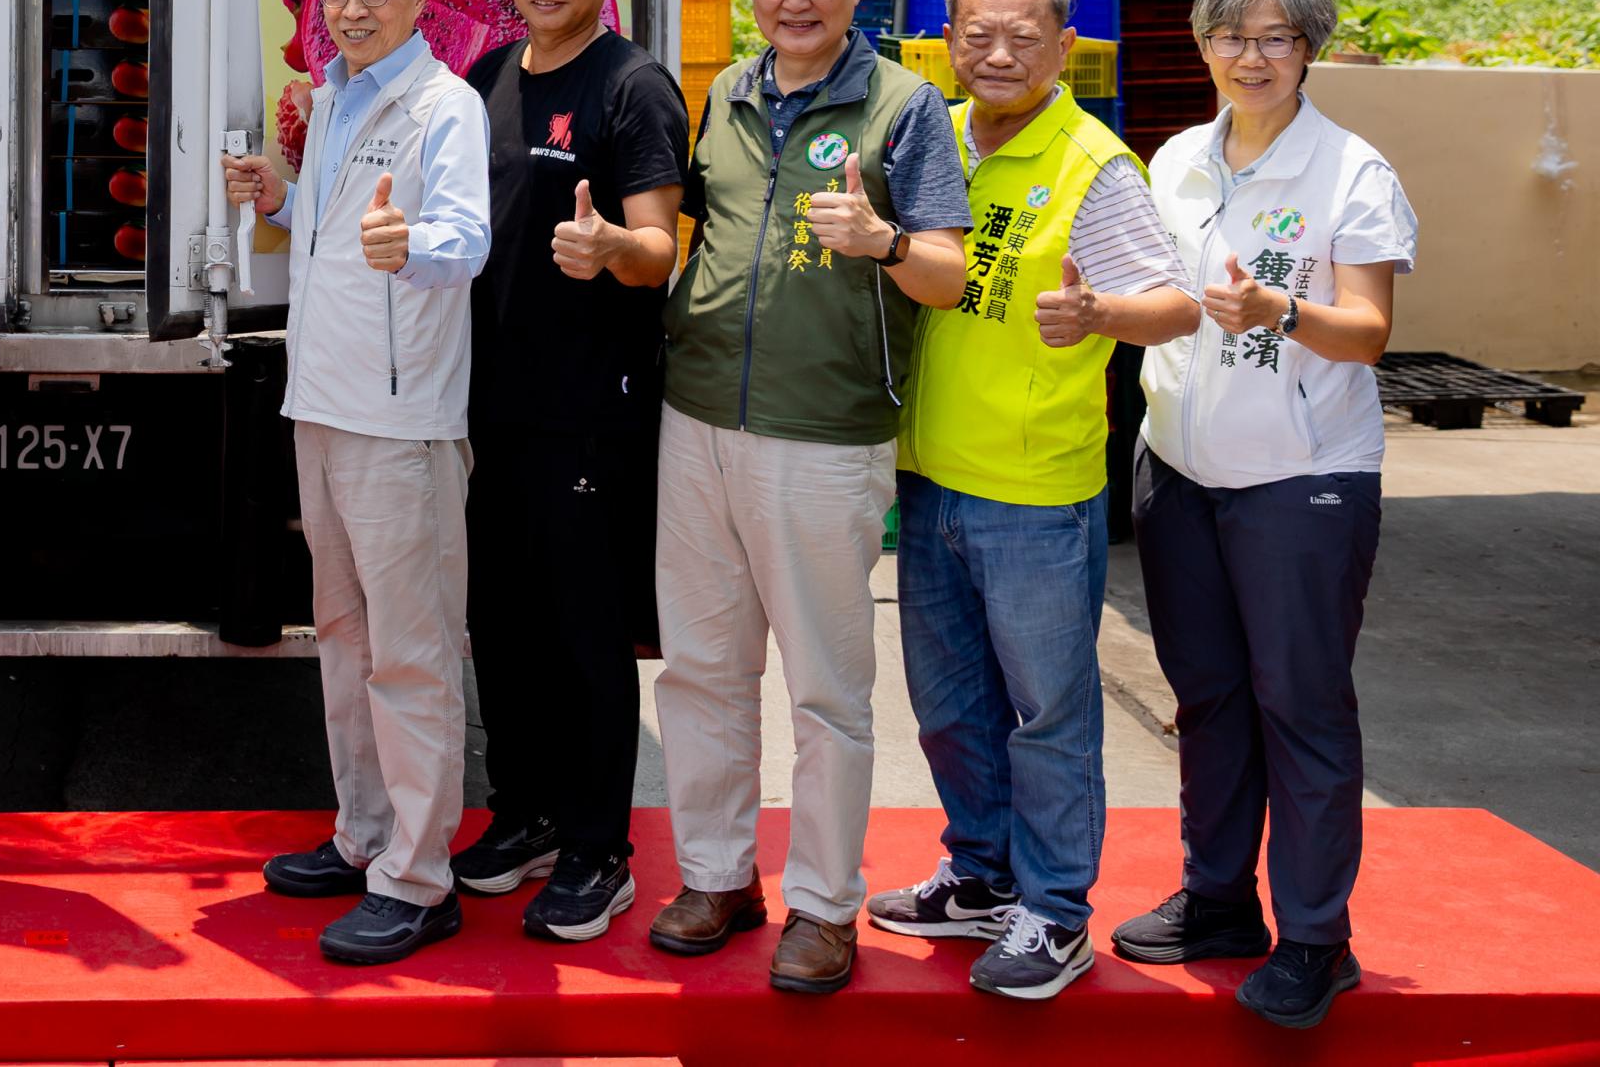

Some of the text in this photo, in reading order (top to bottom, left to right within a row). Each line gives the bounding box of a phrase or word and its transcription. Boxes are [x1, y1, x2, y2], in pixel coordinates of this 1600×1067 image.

[549, 150, 576, 162] DREAM
[787, 192, 813, 272] 徐富癸
[955, 202, 1014, 316] 潘芳泉
[984, 210, 1038, 324] 屏東縣議員
